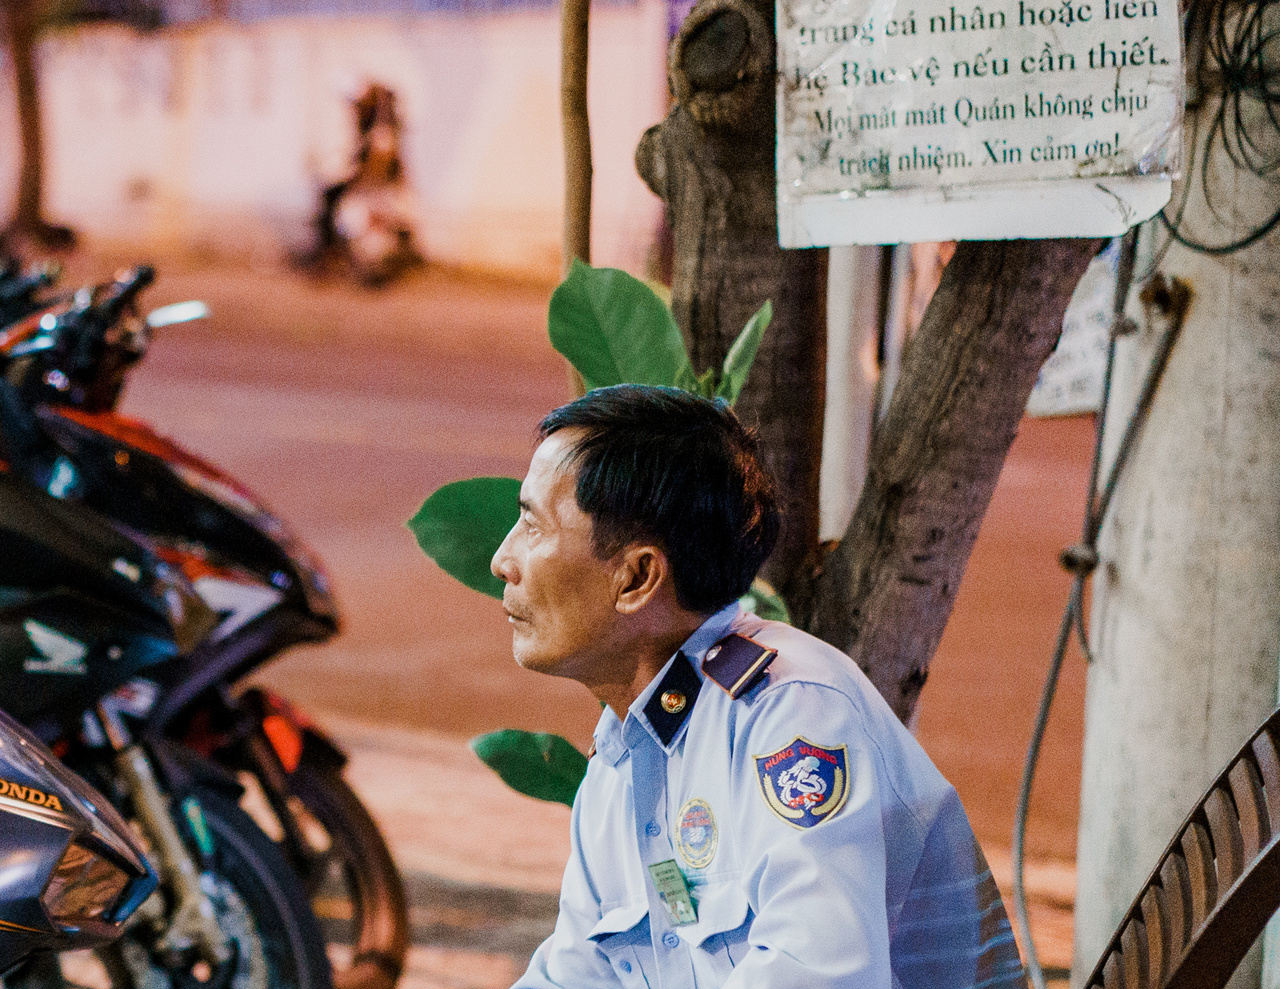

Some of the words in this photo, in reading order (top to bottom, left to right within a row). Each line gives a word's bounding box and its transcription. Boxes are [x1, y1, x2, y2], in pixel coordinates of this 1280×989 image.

[885, 10, 916, 37] cá
[929, 5, 1006, 34] nhân
[1019, 0, 1092, 28] hoặc
[953, 47, 1009, 78] nếu
[1020, 42, 1075, 74] cần
[1088, 36, 1170, 70] thiết.
[905, 102, 946, 127] mát
[954, 96, 1015, 127] Quán
[1024, 91, 1093, 120] không
[1101, 84, 1148, 117] chịu
[898, 144, 972, 174] nhiệm.
[982, 139, 1021, 166] Xin
[1030, 135, 1076, 162] cảm
